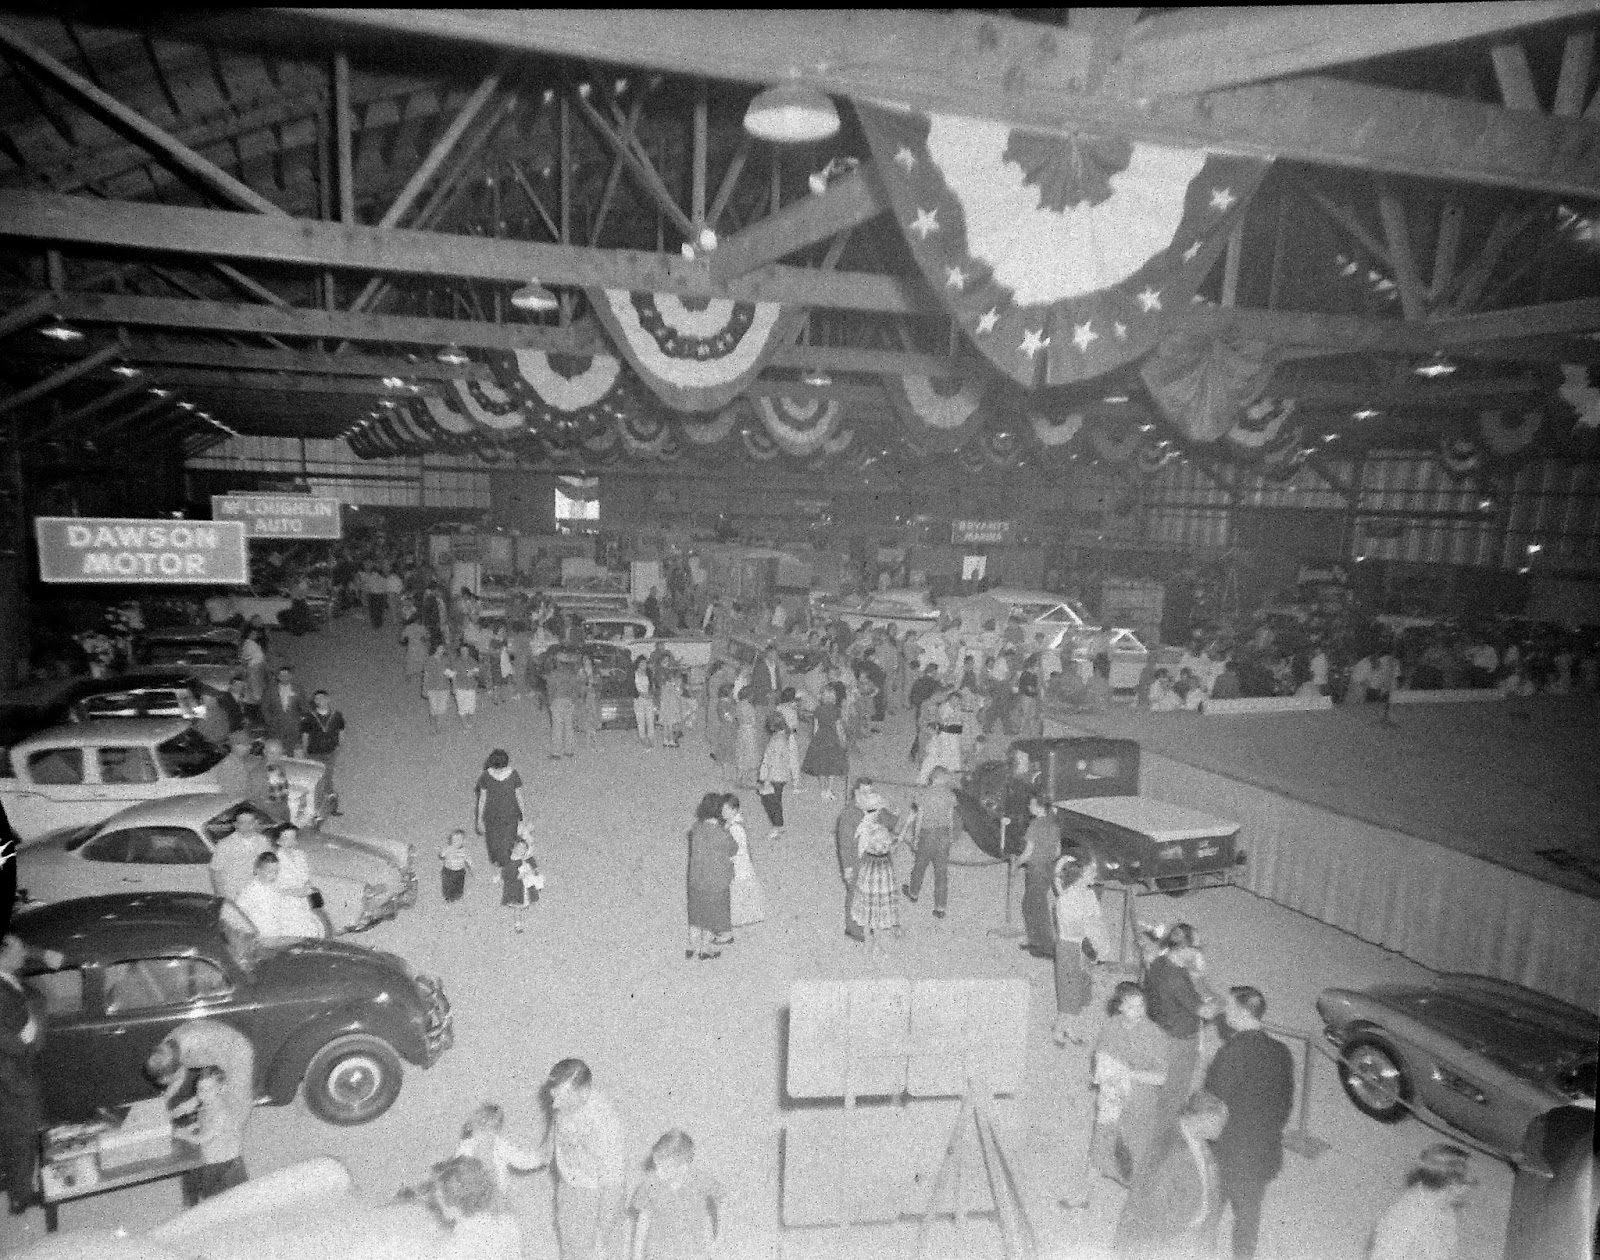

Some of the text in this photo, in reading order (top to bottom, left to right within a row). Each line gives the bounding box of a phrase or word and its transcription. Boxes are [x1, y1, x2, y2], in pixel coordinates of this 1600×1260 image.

[255, 518, 302, 532] AUTO
[66, 525, 217, 549] DAWSON
[83, 552, 206, 575] MOTOR
